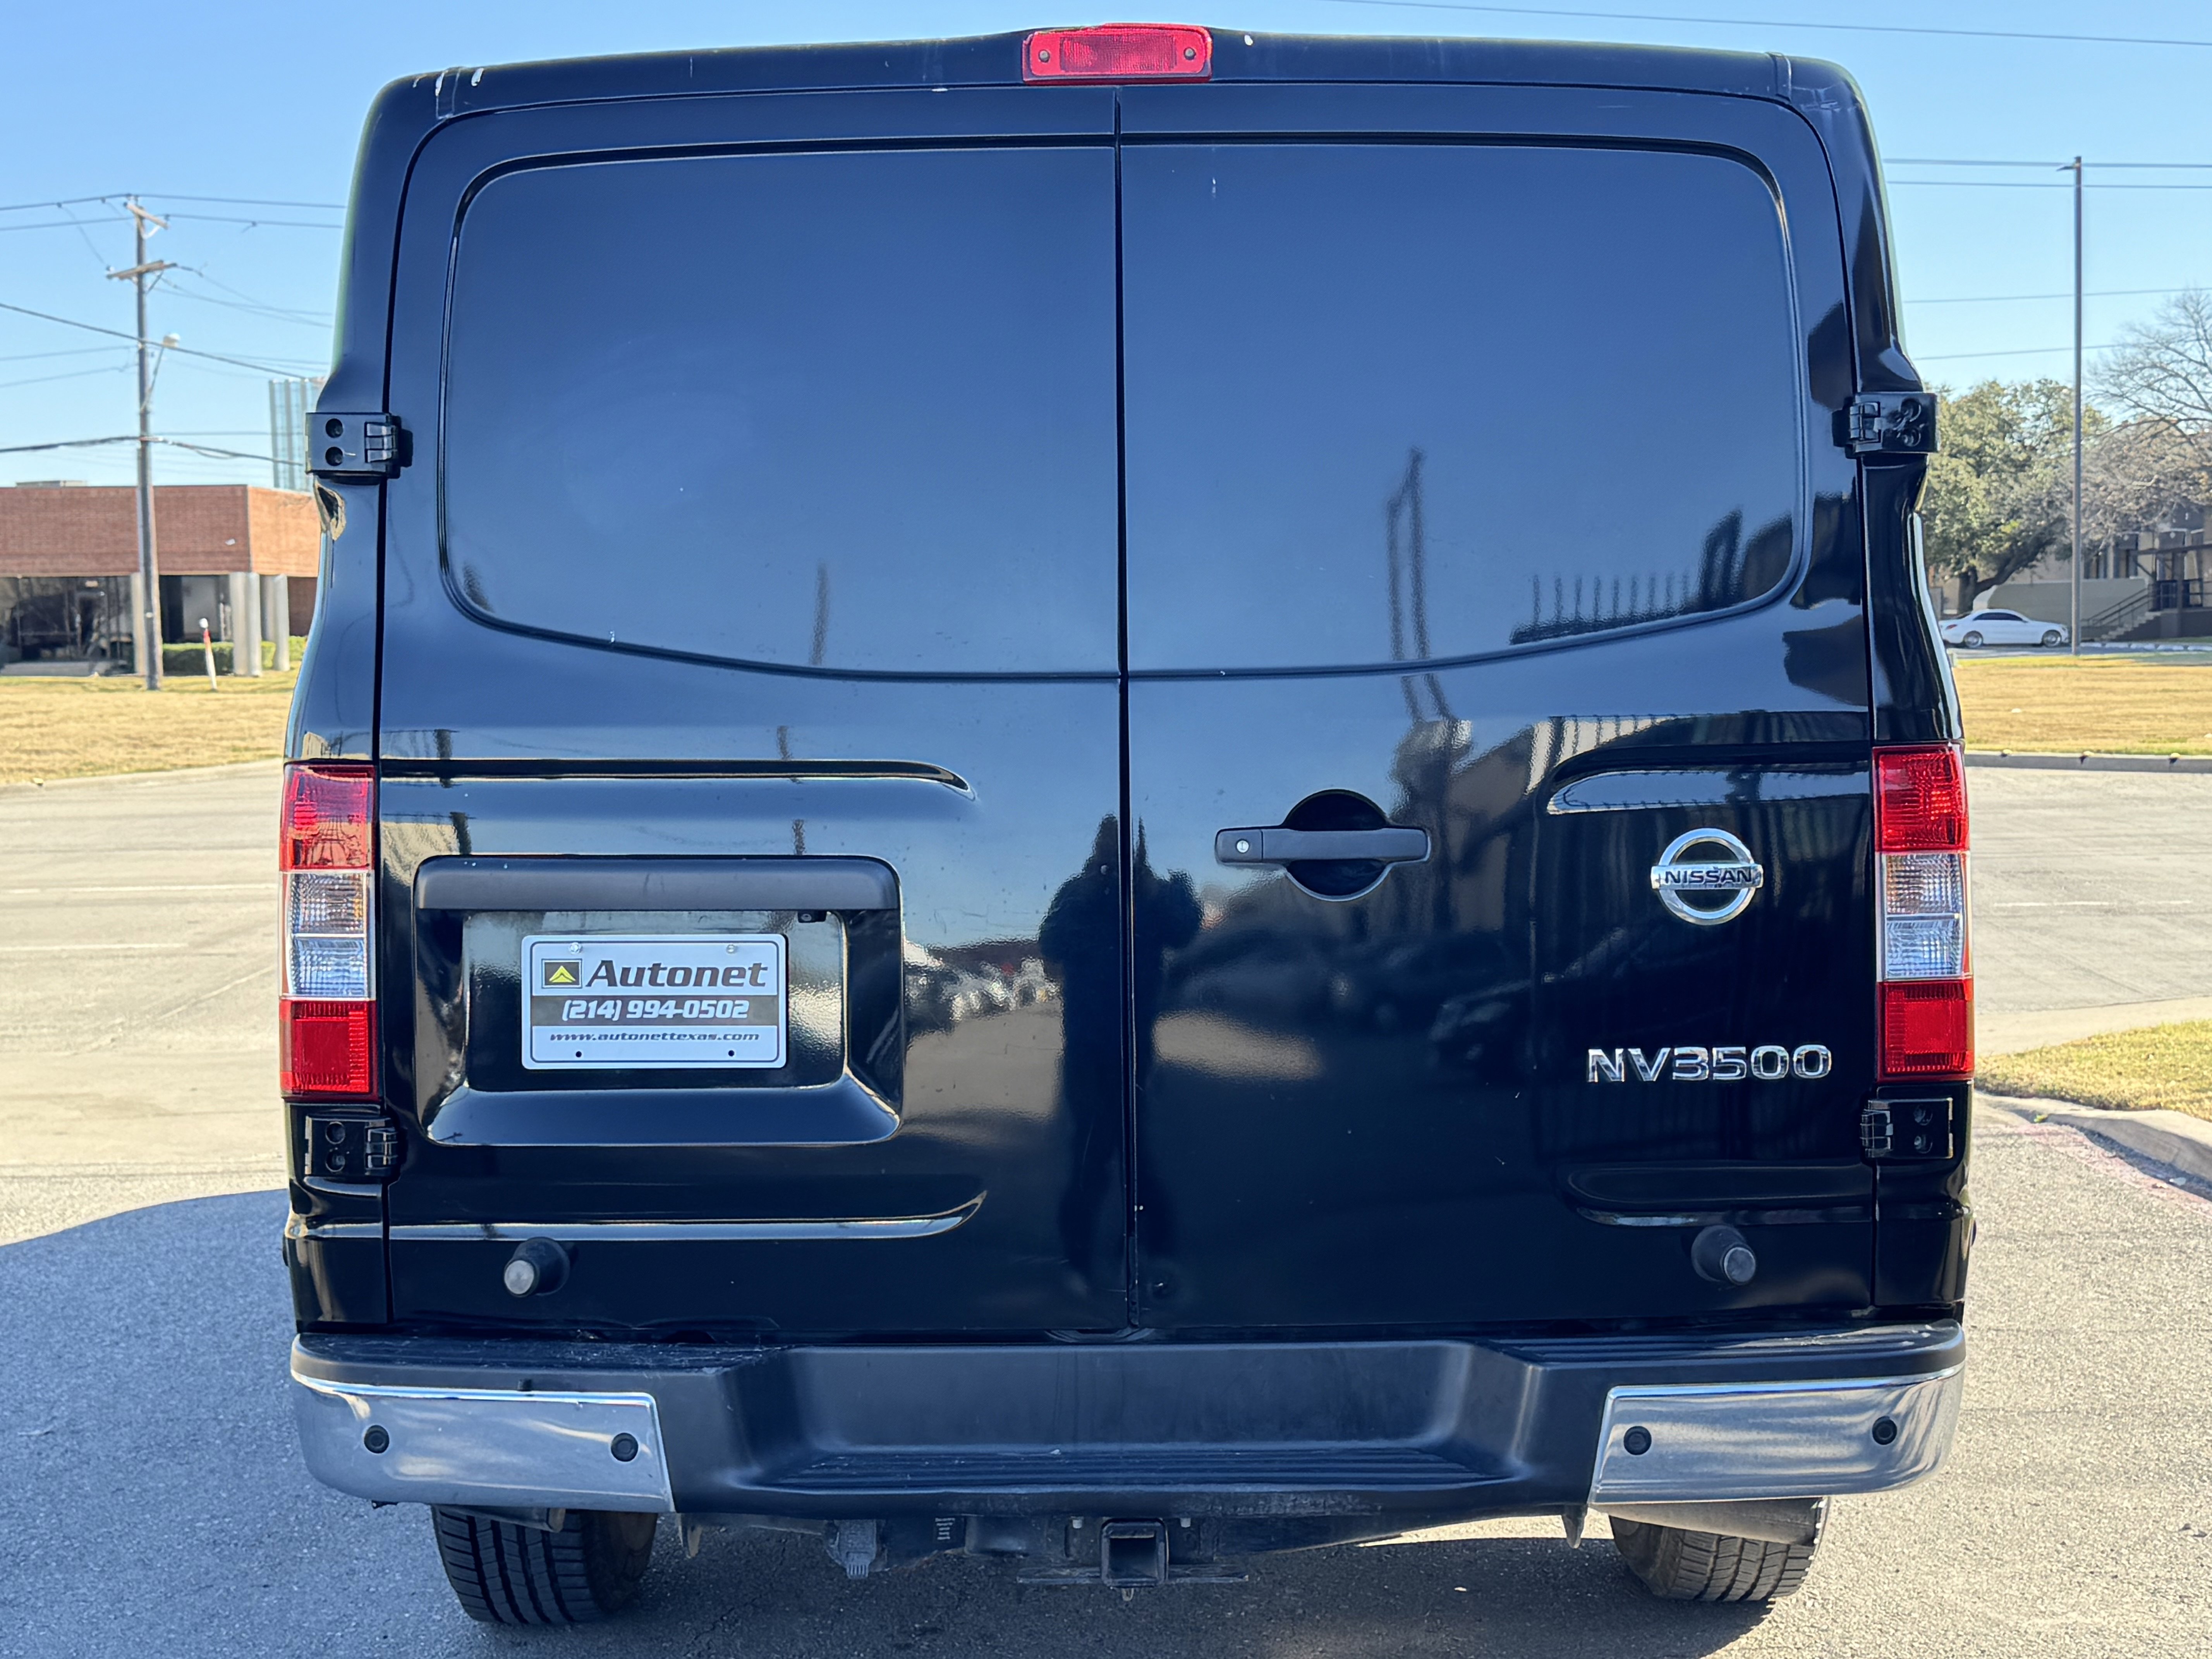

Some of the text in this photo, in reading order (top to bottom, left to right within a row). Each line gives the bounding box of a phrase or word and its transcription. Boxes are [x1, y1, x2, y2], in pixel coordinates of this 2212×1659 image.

[1665, 867, 1752, 884] NISSAN
[586, 960, 768, 987] Autonet
[562, 1000, 749, 1020] (214) 994-0502
[550, 1032, 760, 1041] www.autonettexas.com
[1588, 1044, 1832, 1083] NV3500
